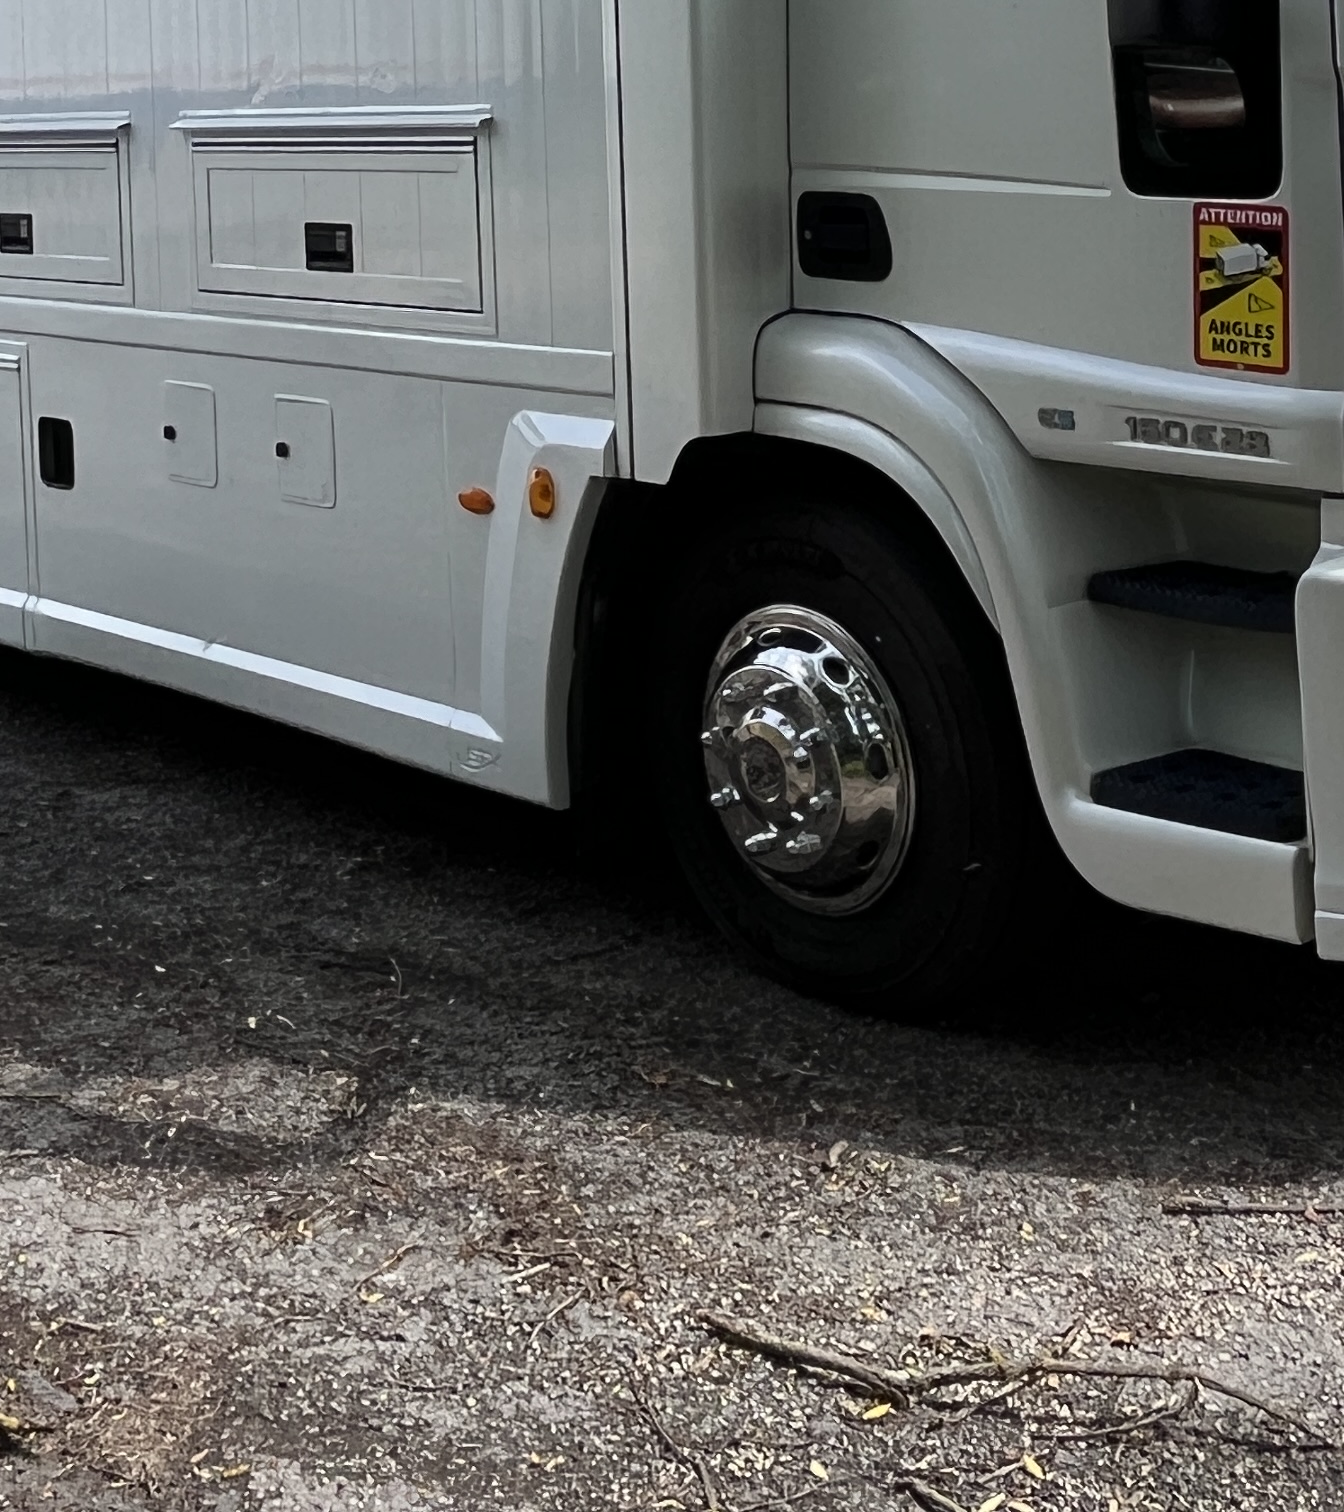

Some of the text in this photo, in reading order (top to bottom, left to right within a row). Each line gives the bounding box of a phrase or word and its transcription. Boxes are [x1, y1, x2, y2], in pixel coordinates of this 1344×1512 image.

[1199, 207, 1284, 226] ATTENTION
[1208, 319, 1275, 340] ANGLES
[1212, 337, 1273, 358] MORTS
